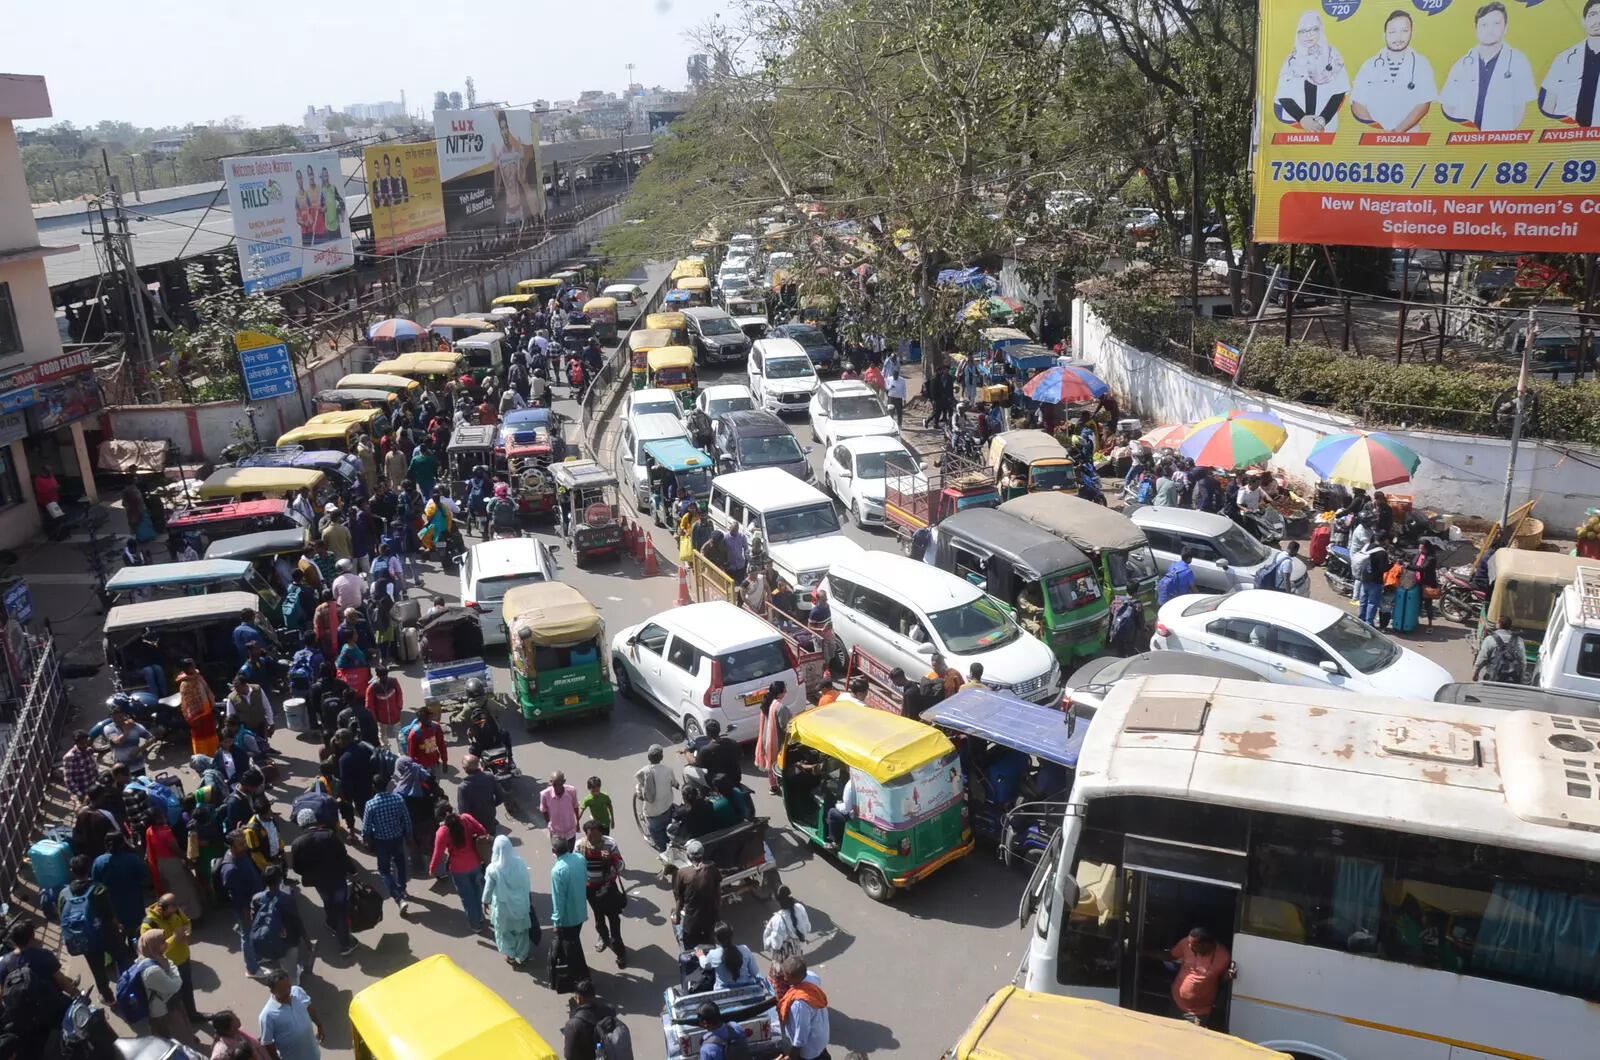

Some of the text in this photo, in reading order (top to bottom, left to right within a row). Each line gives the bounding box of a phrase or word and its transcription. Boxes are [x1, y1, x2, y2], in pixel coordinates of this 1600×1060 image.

[1331, 5, 1350, 15] 720
[451, 119, 475, 132] LUX
[1287, 135, 1320, 143] HALIMA
[1376, 135, 1410, 143] FAIZAN
[1450, 132, 1530, 142] AYUSH PANDEY
[1544, 130, 1583, 140] AYUSH
[1271, 161, 1404, 184] 7360066186
[1433, 162, 1465, 184] 87
[1495, 161, 1528, 184] 88
[1561, 159, 1597, 183] 89
[240, 188, 269, 209] HILLS
[1321, 196, 1355, 210] New
[1359, 197, 1438, 216] Nagratoli,
[1443, 199, 1484, 214] Near
[1489, 199, 1574, 214] Women's
[1382, 219, 1579, 238] Science Block, Ranchi
[40, 354, 82, 376] FOOD PLAZA
